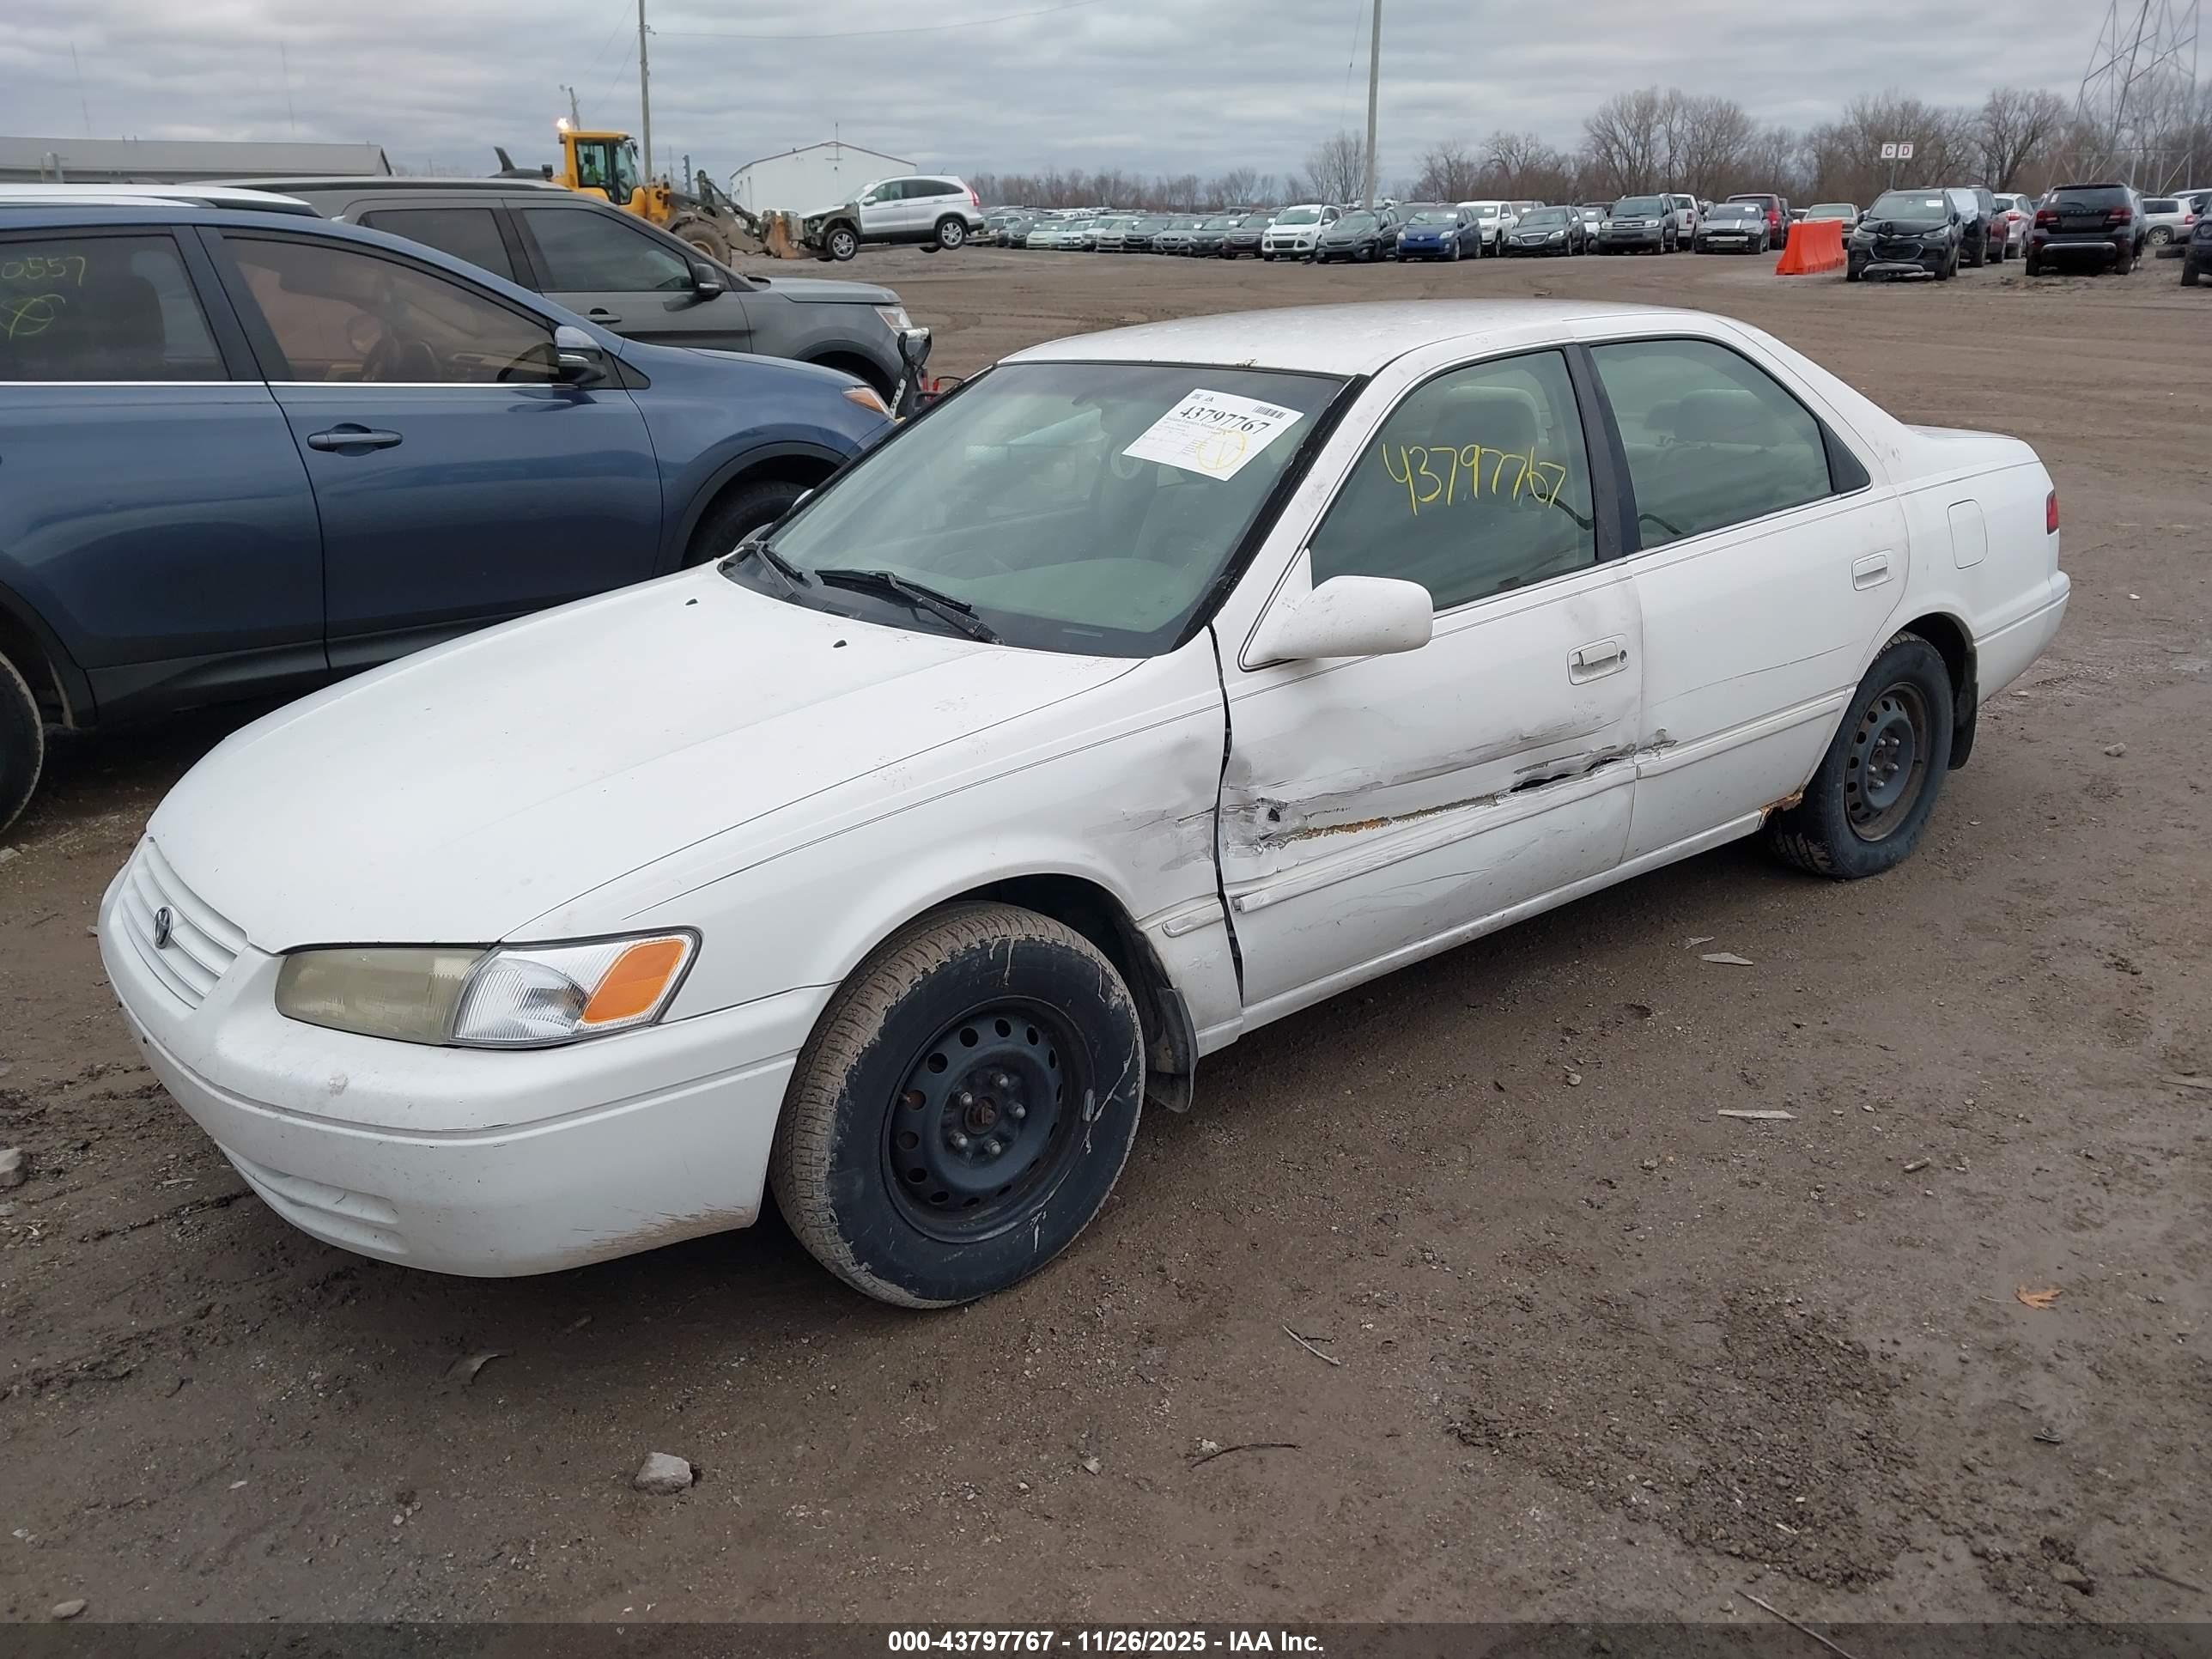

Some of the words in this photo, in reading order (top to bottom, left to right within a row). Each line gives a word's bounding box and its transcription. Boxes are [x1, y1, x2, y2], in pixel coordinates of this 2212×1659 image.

[1885, 145, 1893, 156] C
[1902, 145, 1910, 156] D
[1179, 405, 1272, 434] 43797767
[1382, 442, 1567, 516] 43797767
